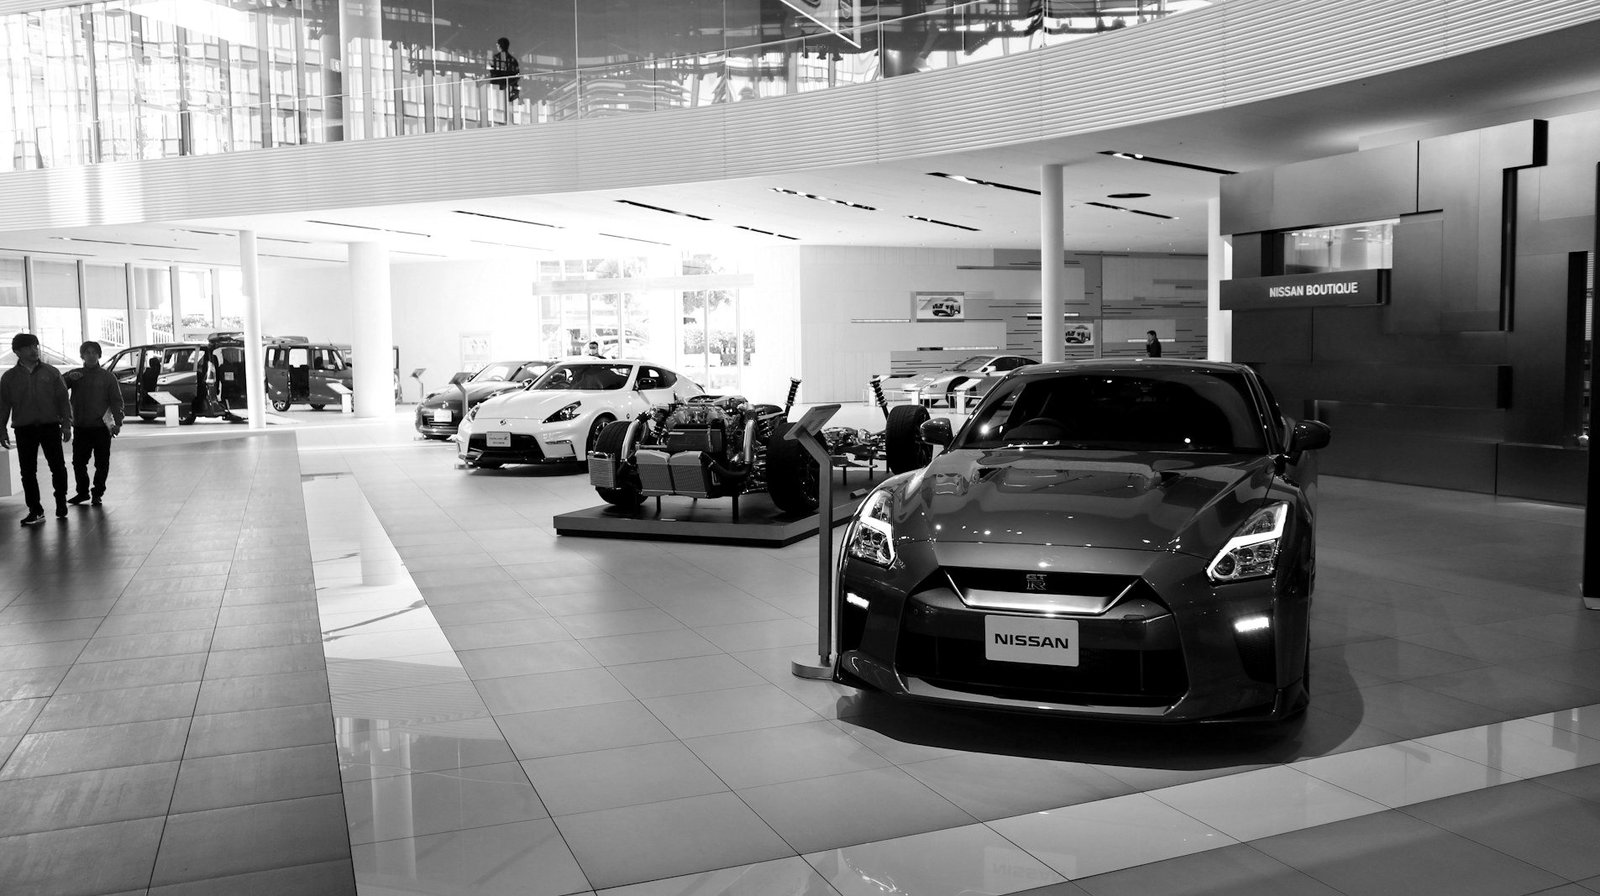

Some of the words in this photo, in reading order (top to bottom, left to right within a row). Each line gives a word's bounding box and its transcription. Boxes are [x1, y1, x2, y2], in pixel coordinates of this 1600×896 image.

[1269, 286, 1304, 298] NISSAN
[1306, 282, 1358, 296] BOUTIQUE
[995, 633, 1069, 649] NISSAN
